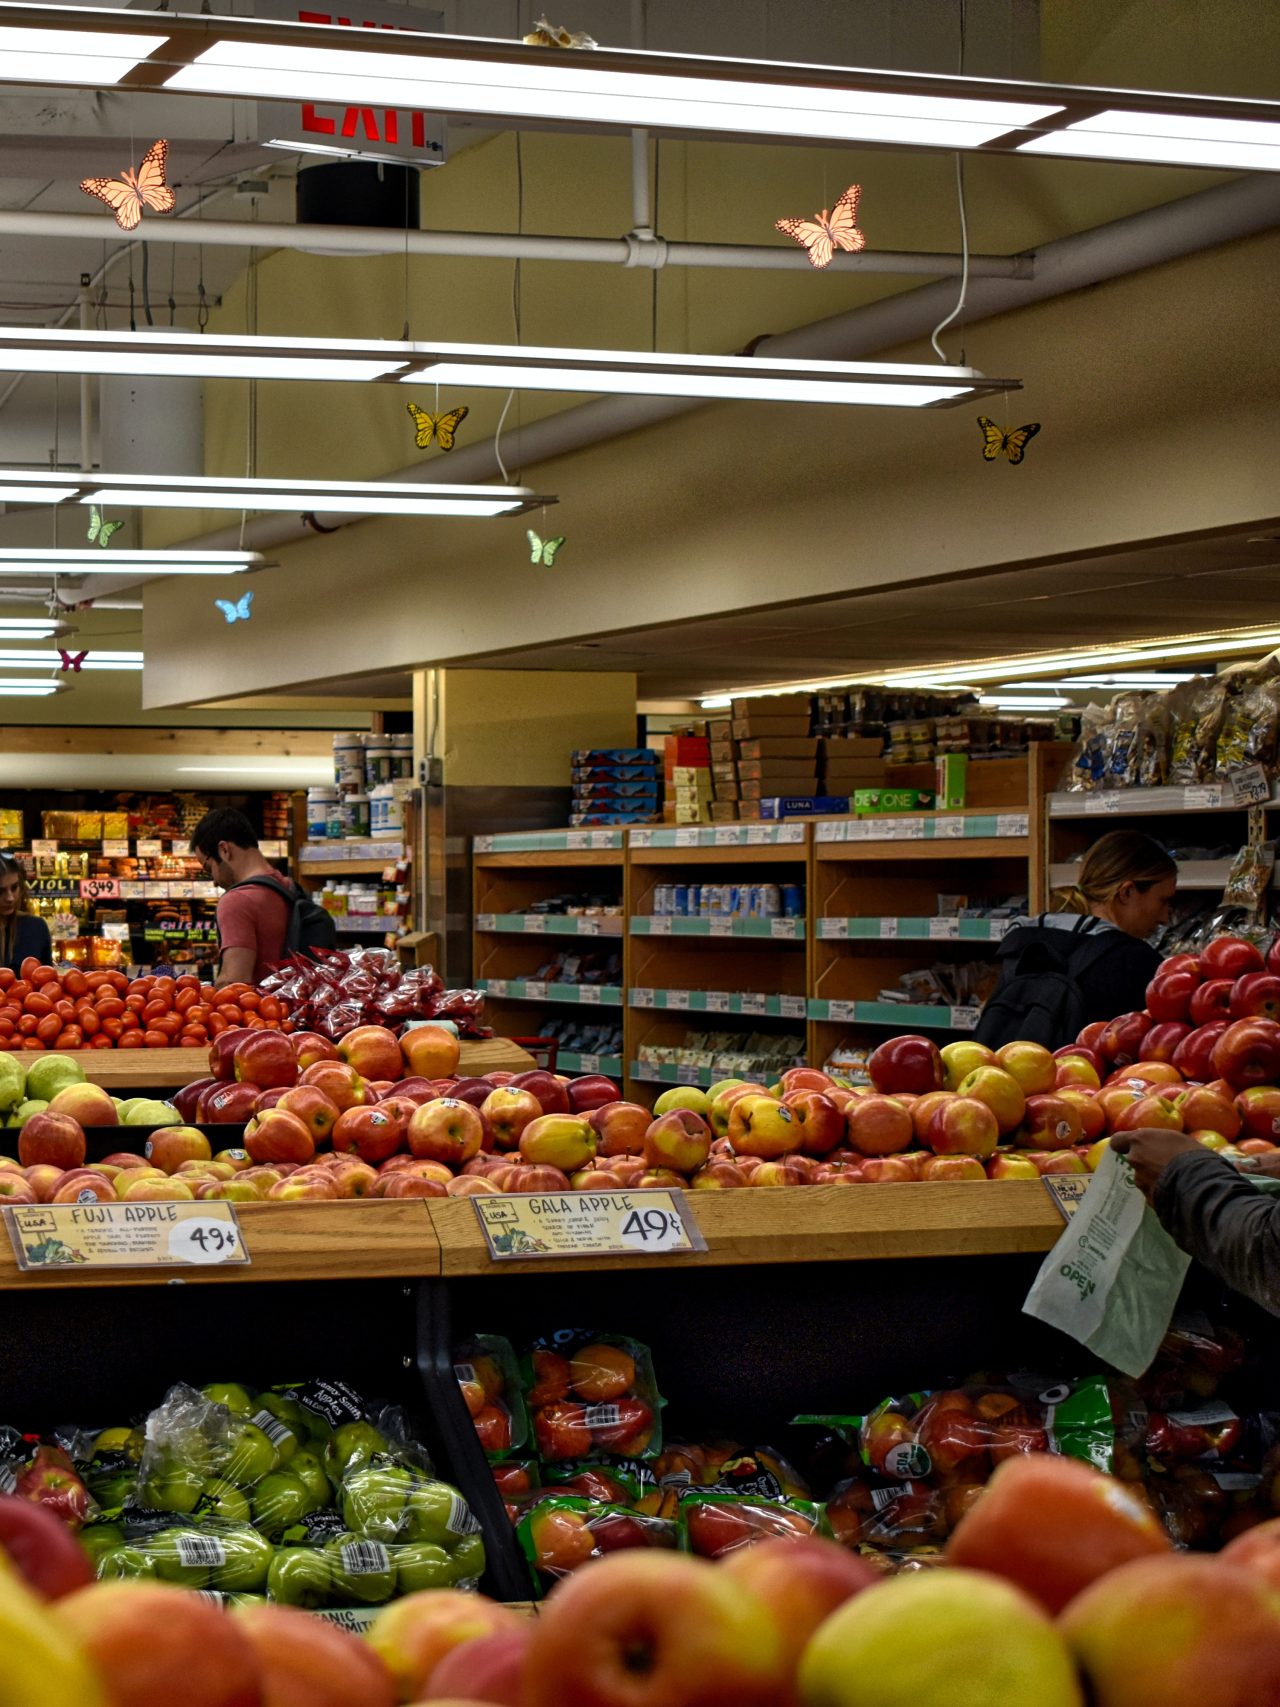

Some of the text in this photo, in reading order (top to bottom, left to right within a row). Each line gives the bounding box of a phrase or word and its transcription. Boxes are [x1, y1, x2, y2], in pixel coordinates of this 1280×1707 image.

[786, 800, 811, 810] LUNA
[883, 793, 912, 807] ONE
[71, 1204, 178, 1224] FUJI APPLE
[489, 1210, 508, 1220] USA
[529, 1195, 634, 1215] GALA APPLE
[24, 1218, 47, 1227] USA
[1059, 1264, 1096, 1294] OPEN
[313, 1389, 343, 1416] Apples
[338, 1396, 361, 1420] Smith
